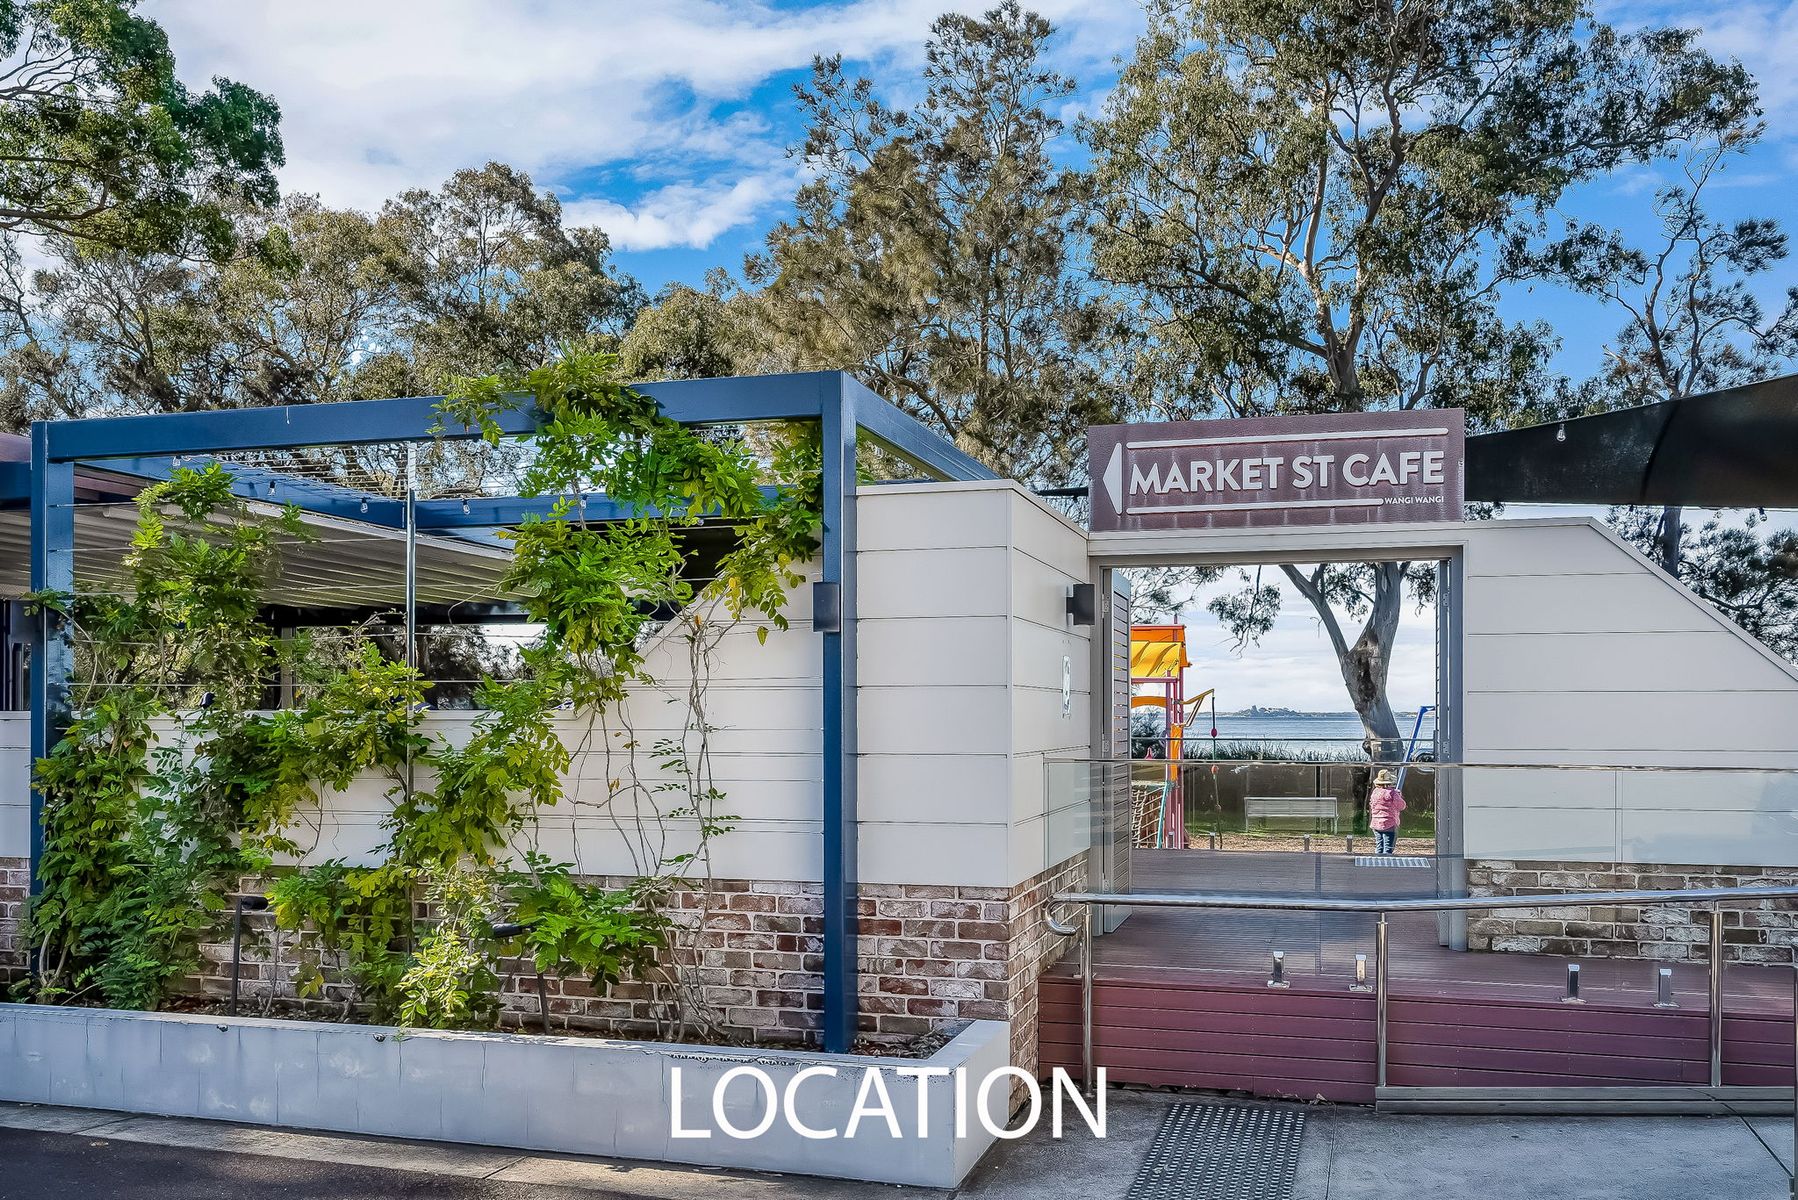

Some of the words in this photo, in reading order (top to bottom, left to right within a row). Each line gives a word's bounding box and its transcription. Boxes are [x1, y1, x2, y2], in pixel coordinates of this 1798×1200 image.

[1129, 457, 1284, 495] MARKET
[1291, 455, 1335, 488] ST
[1342, 451, 1445, 487] CAFE
[1384, 496, 1414, 505] WANGI
[1415, 495, 1444, 504] WANGI
